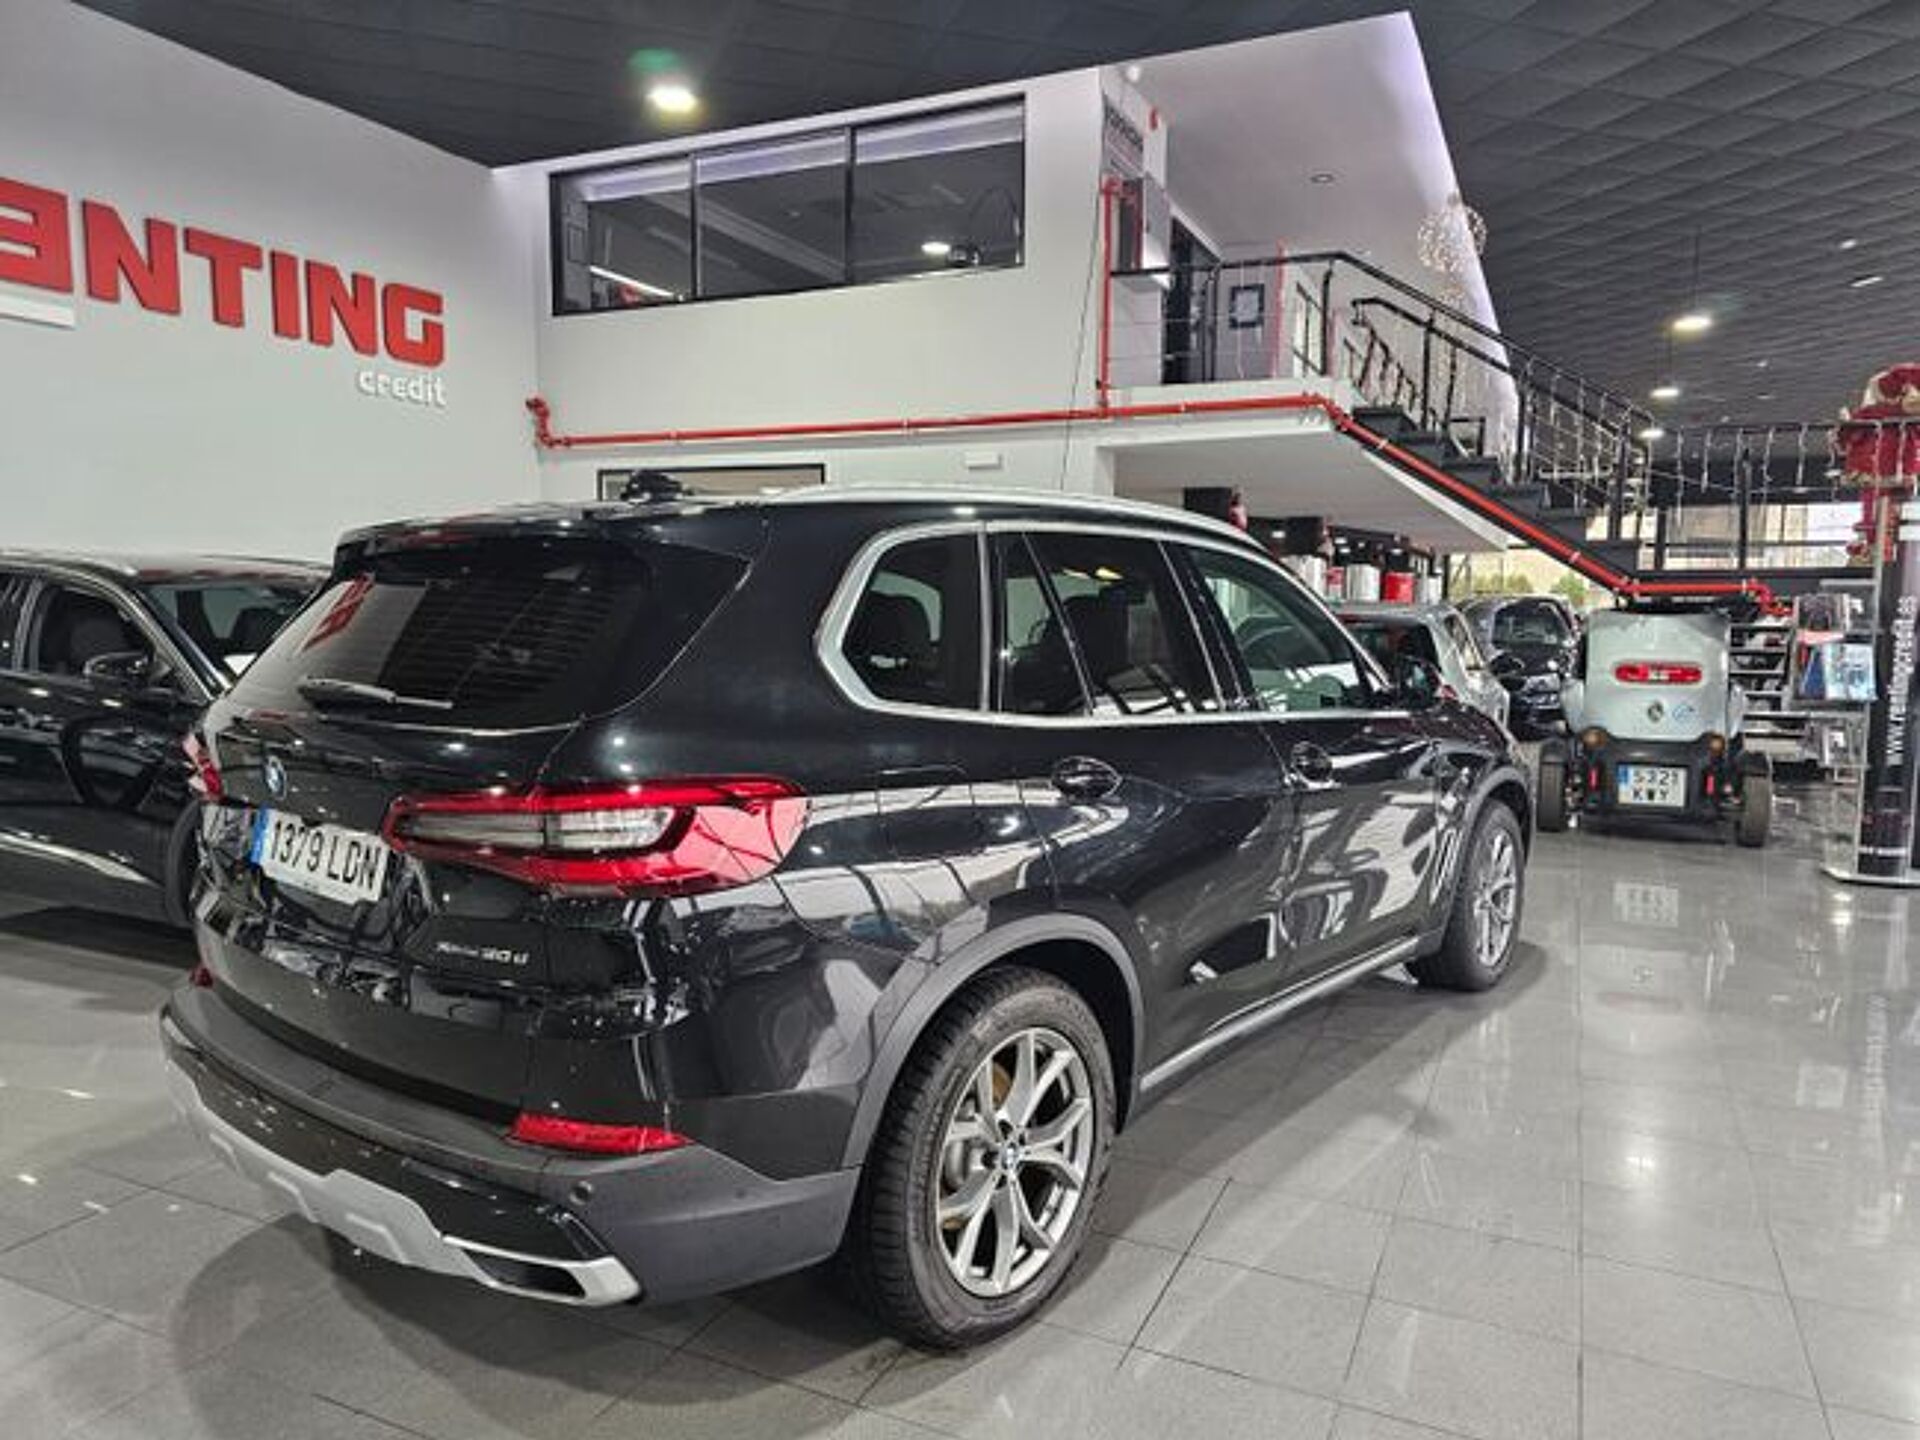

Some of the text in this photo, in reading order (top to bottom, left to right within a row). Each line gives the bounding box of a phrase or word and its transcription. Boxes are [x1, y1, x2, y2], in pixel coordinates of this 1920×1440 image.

[358, 371, 447, 405] credit
[270, 819, 381, 891] 1379 LDN
